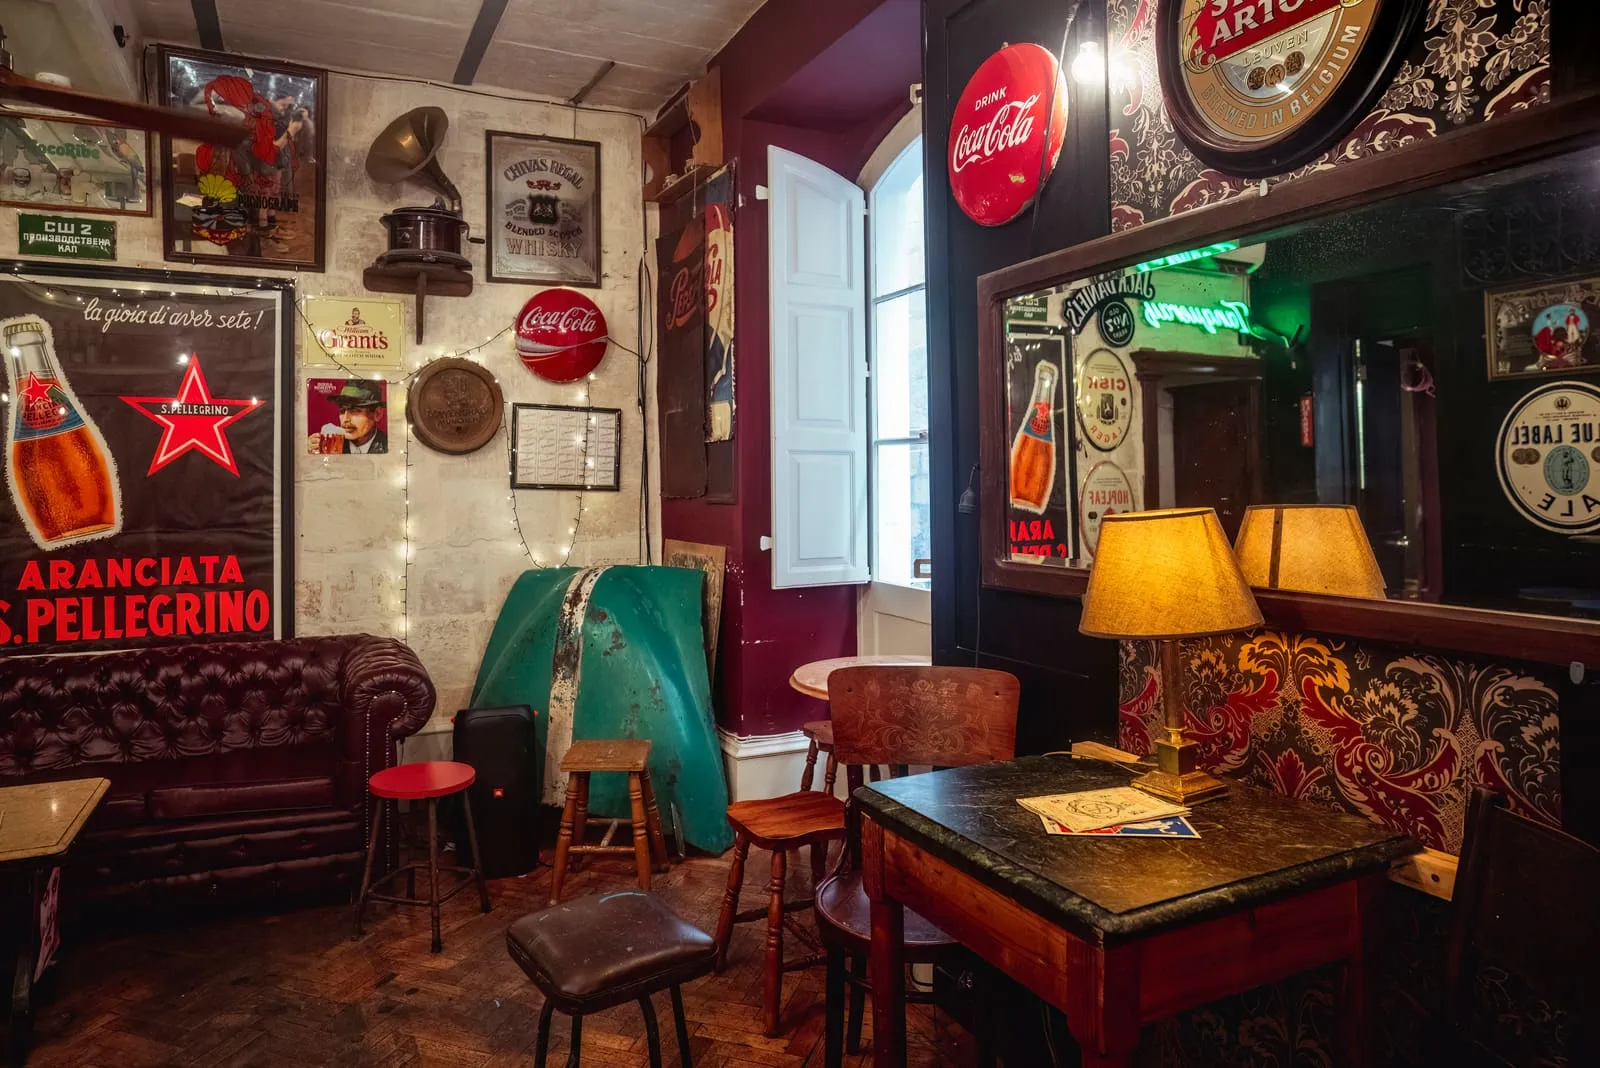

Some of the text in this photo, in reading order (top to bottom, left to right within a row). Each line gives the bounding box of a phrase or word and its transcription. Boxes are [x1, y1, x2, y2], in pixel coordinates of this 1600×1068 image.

[1211, 0, 1318, 48] ARTO
[1243, 30, 1309, 67] LEUVEN
[1201, 25, 1361, 130] BREWED IN BELGIUM
[975, 86, 1007, 111] DRINK
[953, 92, 1041, 173] Coca-Cola
[503, 159, 585, 190] CHIVAS REGAL
[44, 221, 92, 235] СШ 2
[505, 221, 583, 240] BLENDED SCOTCH
[505, 238, 582, 258] WHISKY
[85, 297, 101, 321] la
[103, 303, 146, 333] gioia
[149, 305, 170, 325] di
[169, 309, 214, 327] aver
[522, 306, 599, 332] Coca-Cola
[161, 404, 228, 415] S.PELLEGRINO
[16, 555, 244, 591] ARANCIATA
[0, 589, 270, 645] S.PELLEGRINO
